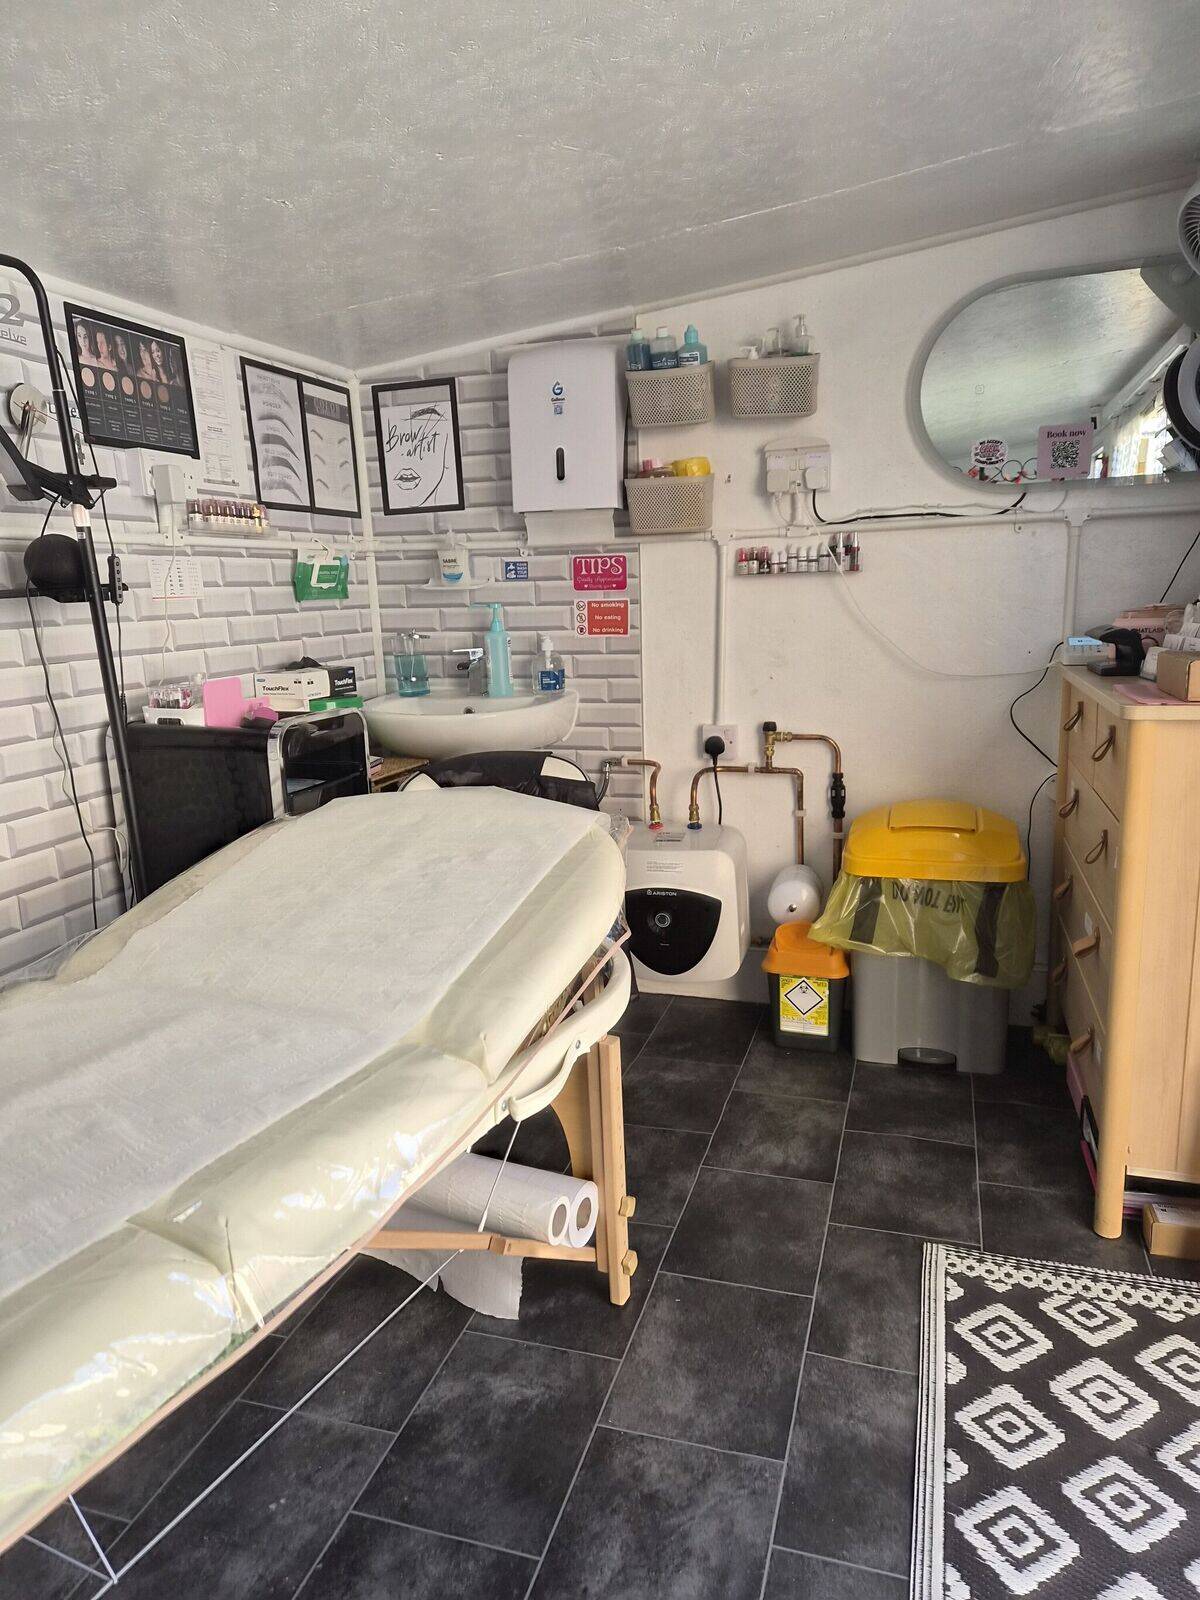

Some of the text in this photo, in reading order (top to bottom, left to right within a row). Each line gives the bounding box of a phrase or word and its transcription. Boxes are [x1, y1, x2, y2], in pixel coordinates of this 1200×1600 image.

[0, 328, 27, 344] elve
[386, 417, 423, 453] Brow
[1047, 429, 1087, 439] Book now
[406, 431, 440, 461] artist
[576, 557, 624, 575] TIPS
